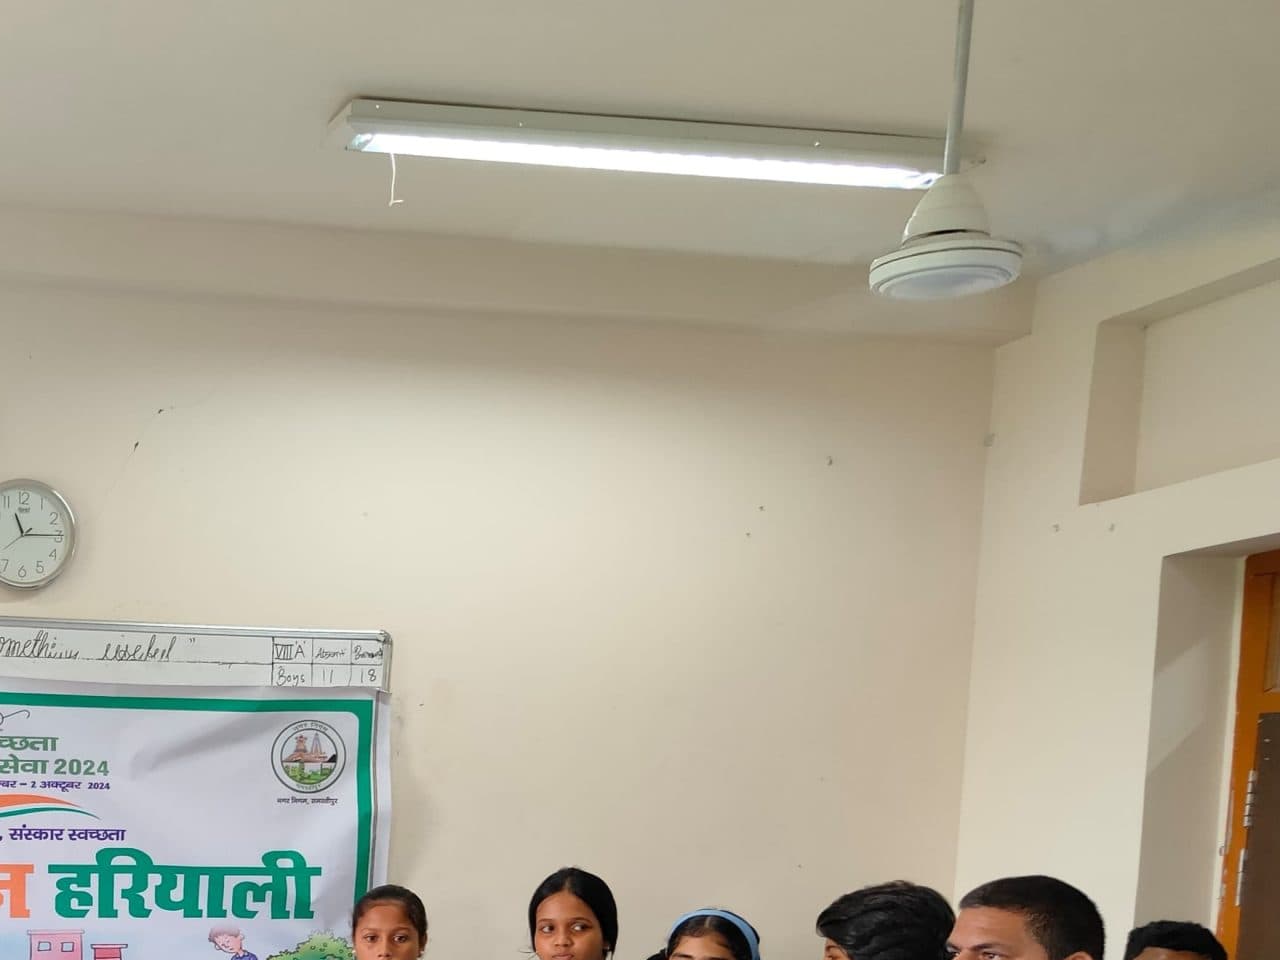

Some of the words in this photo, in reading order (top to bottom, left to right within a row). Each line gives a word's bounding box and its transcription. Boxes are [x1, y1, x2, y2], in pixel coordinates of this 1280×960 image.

[3, 495, 10, 508] 11
[18, 491, 30, 505] 12
[50, 512, 59, 525] 2
[54, 530, 63, 543] 3
[48, 549, 57, 561] 4
[1, 559, 9, 572] 7
[18, 564, 27, 578] 6
[36, 561, 44, 574] 5
[276, 666, 305, 687] Boys
[360, 668, 377, 683] 18
[54, 758, 109, 776] 2024
[40, 779, 82, 792] अक्टूबर
[88, 782, 111, 790] 2024
[9, 824, 64, 841] संस्कार
[68, 828, 126, 841] स्वच्छता
[48, 847, 322, 919] हरियाली
